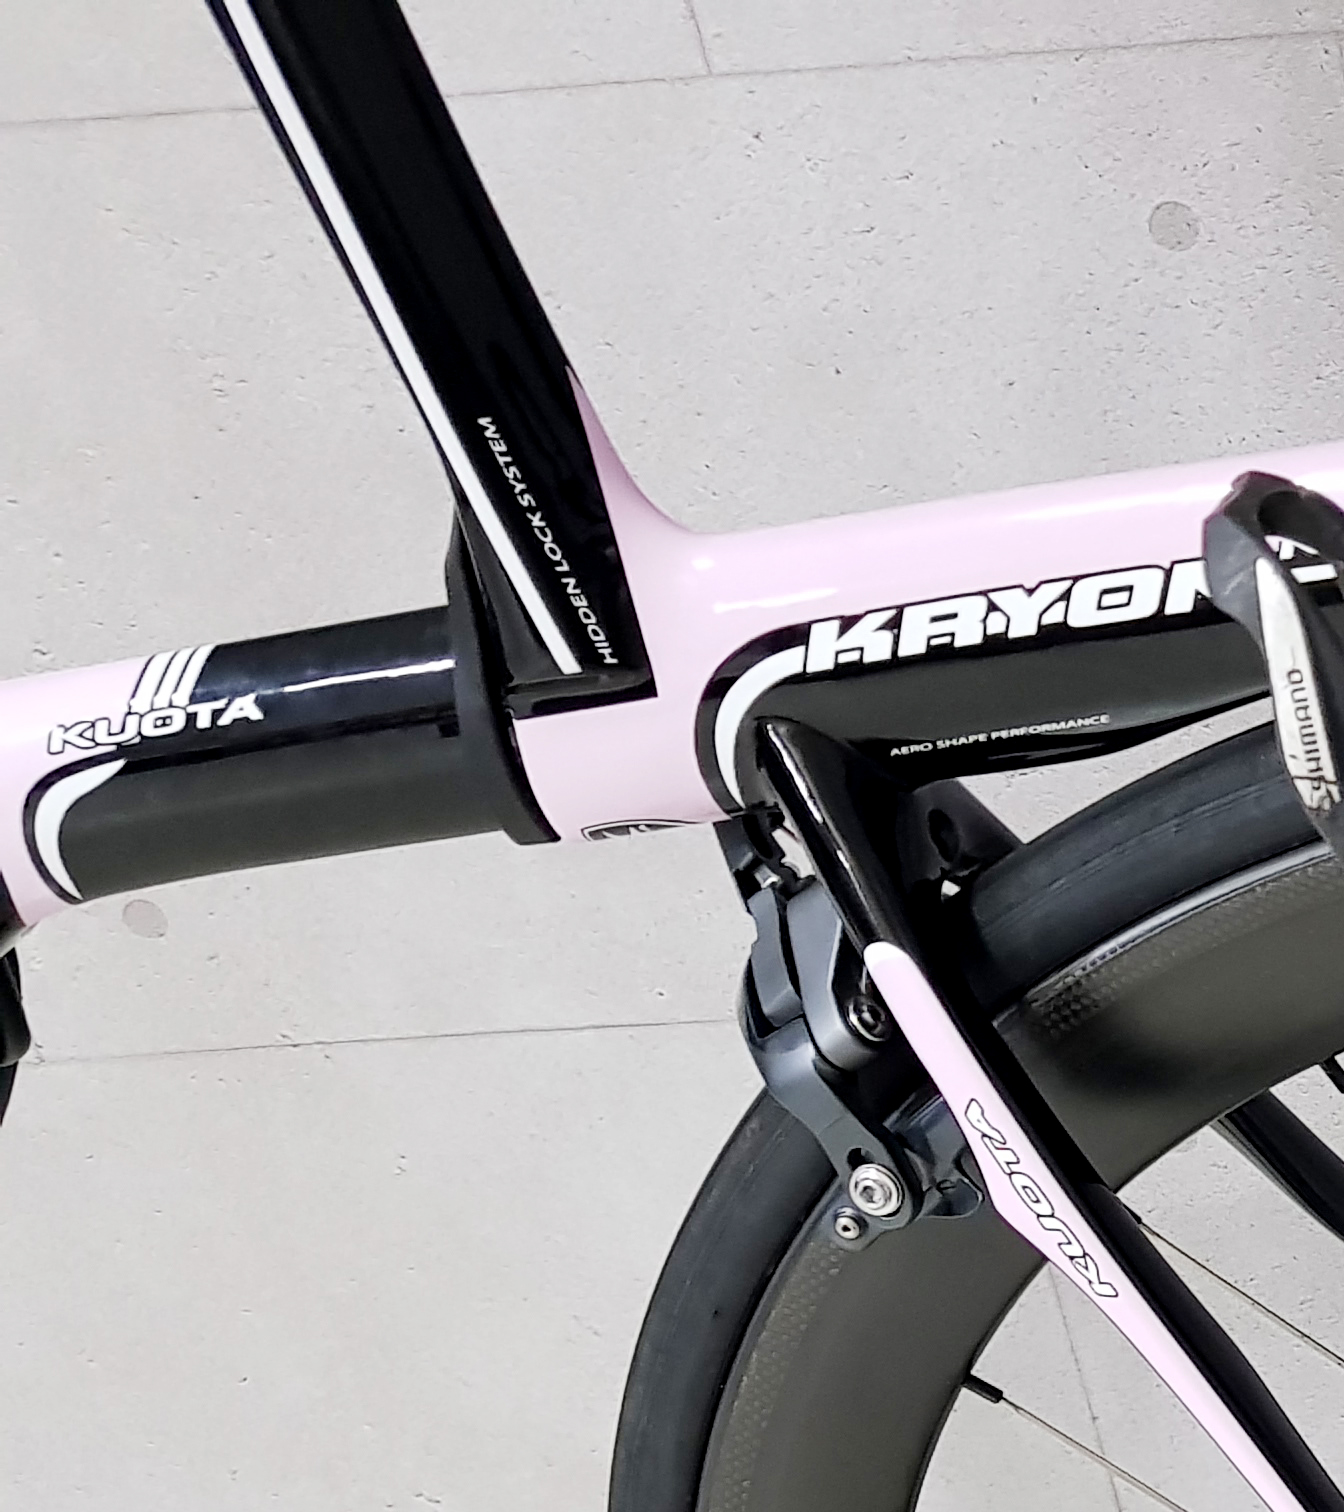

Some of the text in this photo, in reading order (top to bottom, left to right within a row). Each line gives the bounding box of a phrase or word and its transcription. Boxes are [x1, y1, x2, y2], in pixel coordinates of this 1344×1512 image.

[476, 416, 618, 665] HIDDEN LOCK SYSTEM
[47, 693, 264, 756] KUOTA
[890, 714, 1111, 757] AERO SHAPE PERFORMANCE
[1286, 668, 1325, 791] SHIMANO
[964, 1097, 1119, 1298] KUOTA
